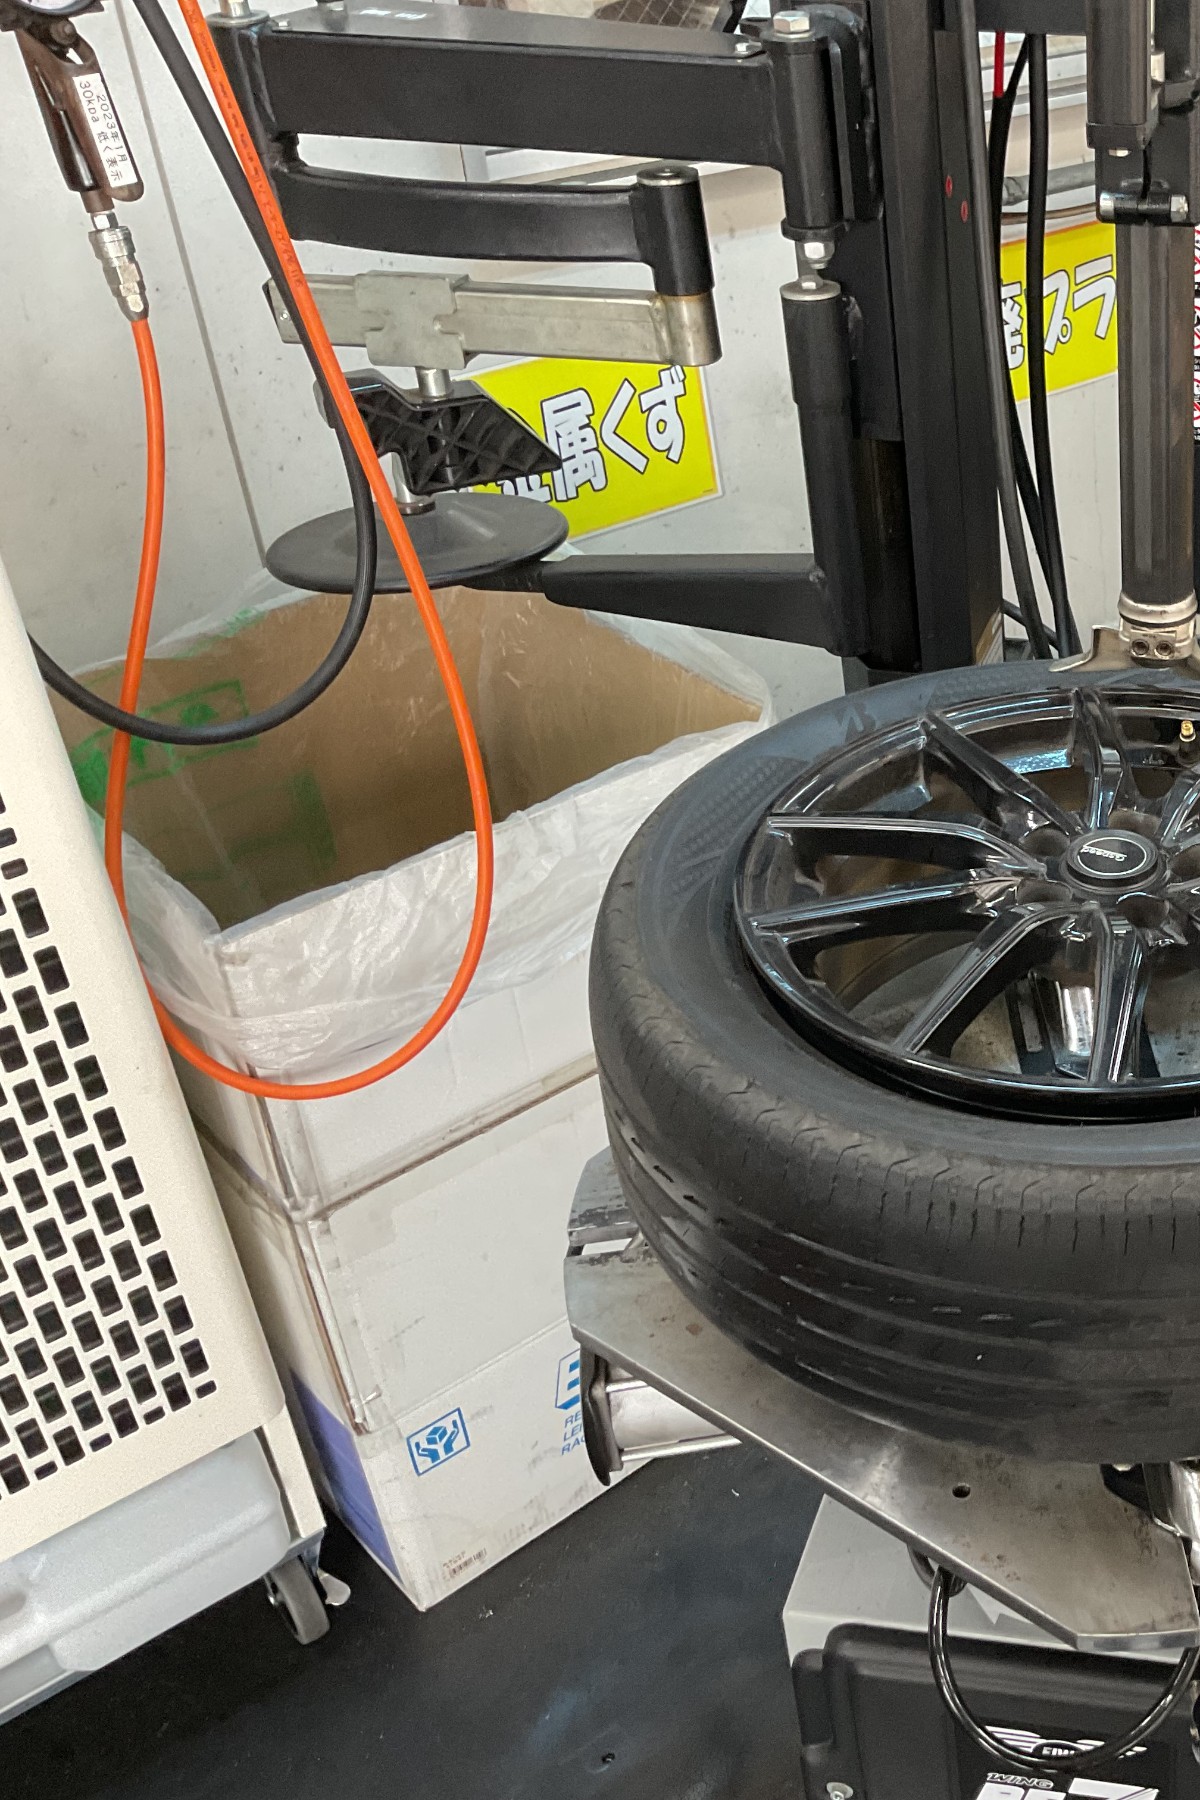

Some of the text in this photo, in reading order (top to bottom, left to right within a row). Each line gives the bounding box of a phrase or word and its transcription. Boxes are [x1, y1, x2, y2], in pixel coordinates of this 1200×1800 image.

[500, 364, 687, 503] 属くず
[986, 1773, 1055, 1790] WING
